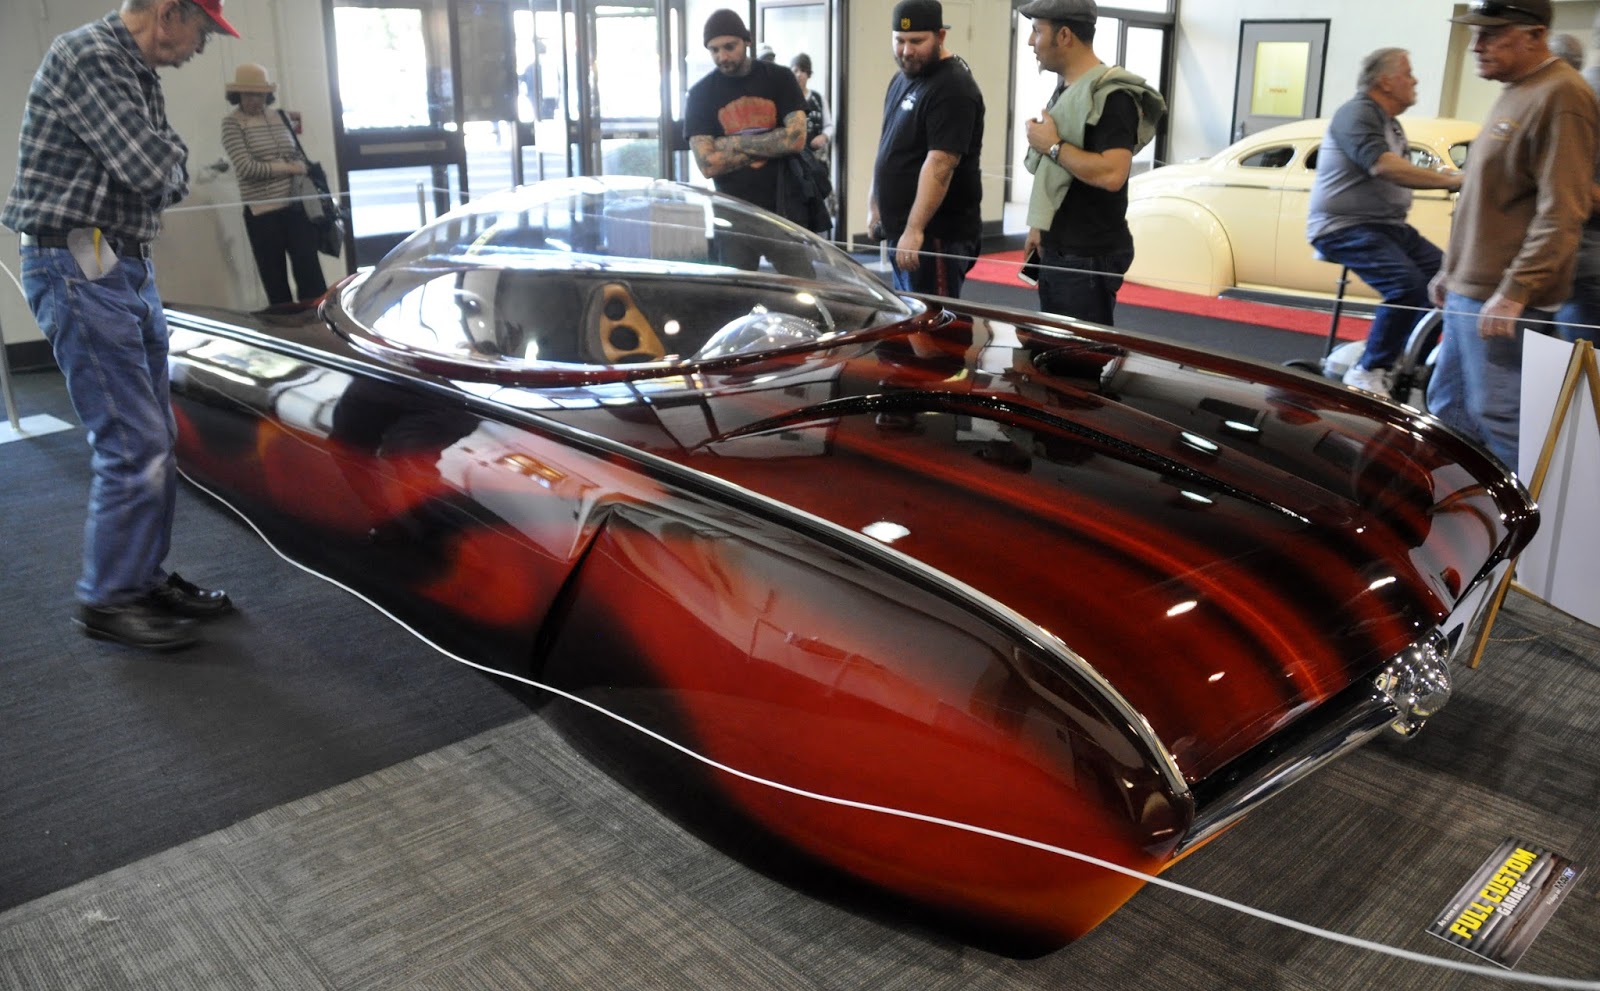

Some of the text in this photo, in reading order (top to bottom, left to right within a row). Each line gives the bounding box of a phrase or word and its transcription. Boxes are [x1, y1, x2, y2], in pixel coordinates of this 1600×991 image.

[1448, 847, 1538, 940] FULL CUSTOM
[1496, 881, 1532, 916] GARAGE
[1437, 918, 1447, 927] As
